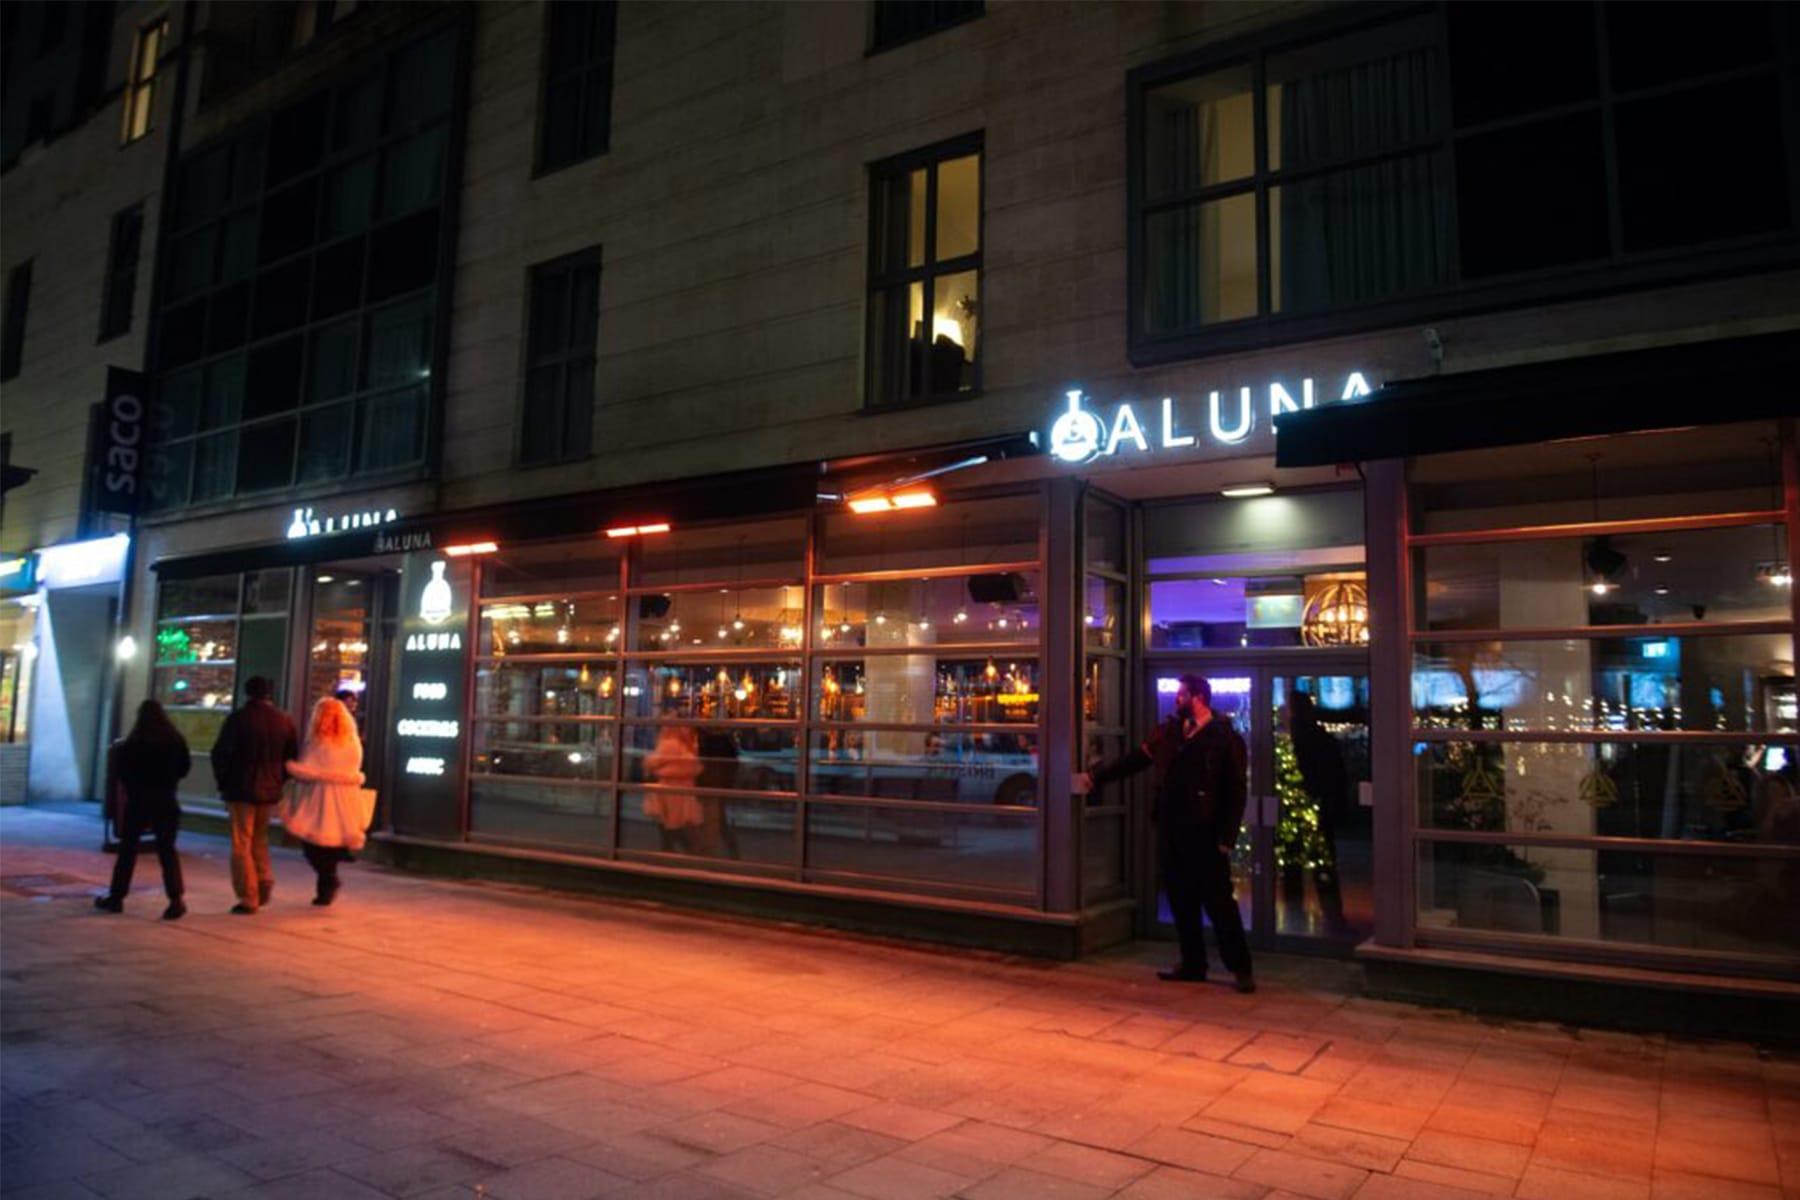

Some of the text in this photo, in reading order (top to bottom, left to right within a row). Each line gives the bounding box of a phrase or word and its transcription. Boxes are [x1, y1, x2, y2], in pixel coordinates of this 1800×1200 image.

[104, 393, 143, 495] saco
[386, 531, 432, 550] ALUNA
[405, 632, 462, 651] ALUNA
